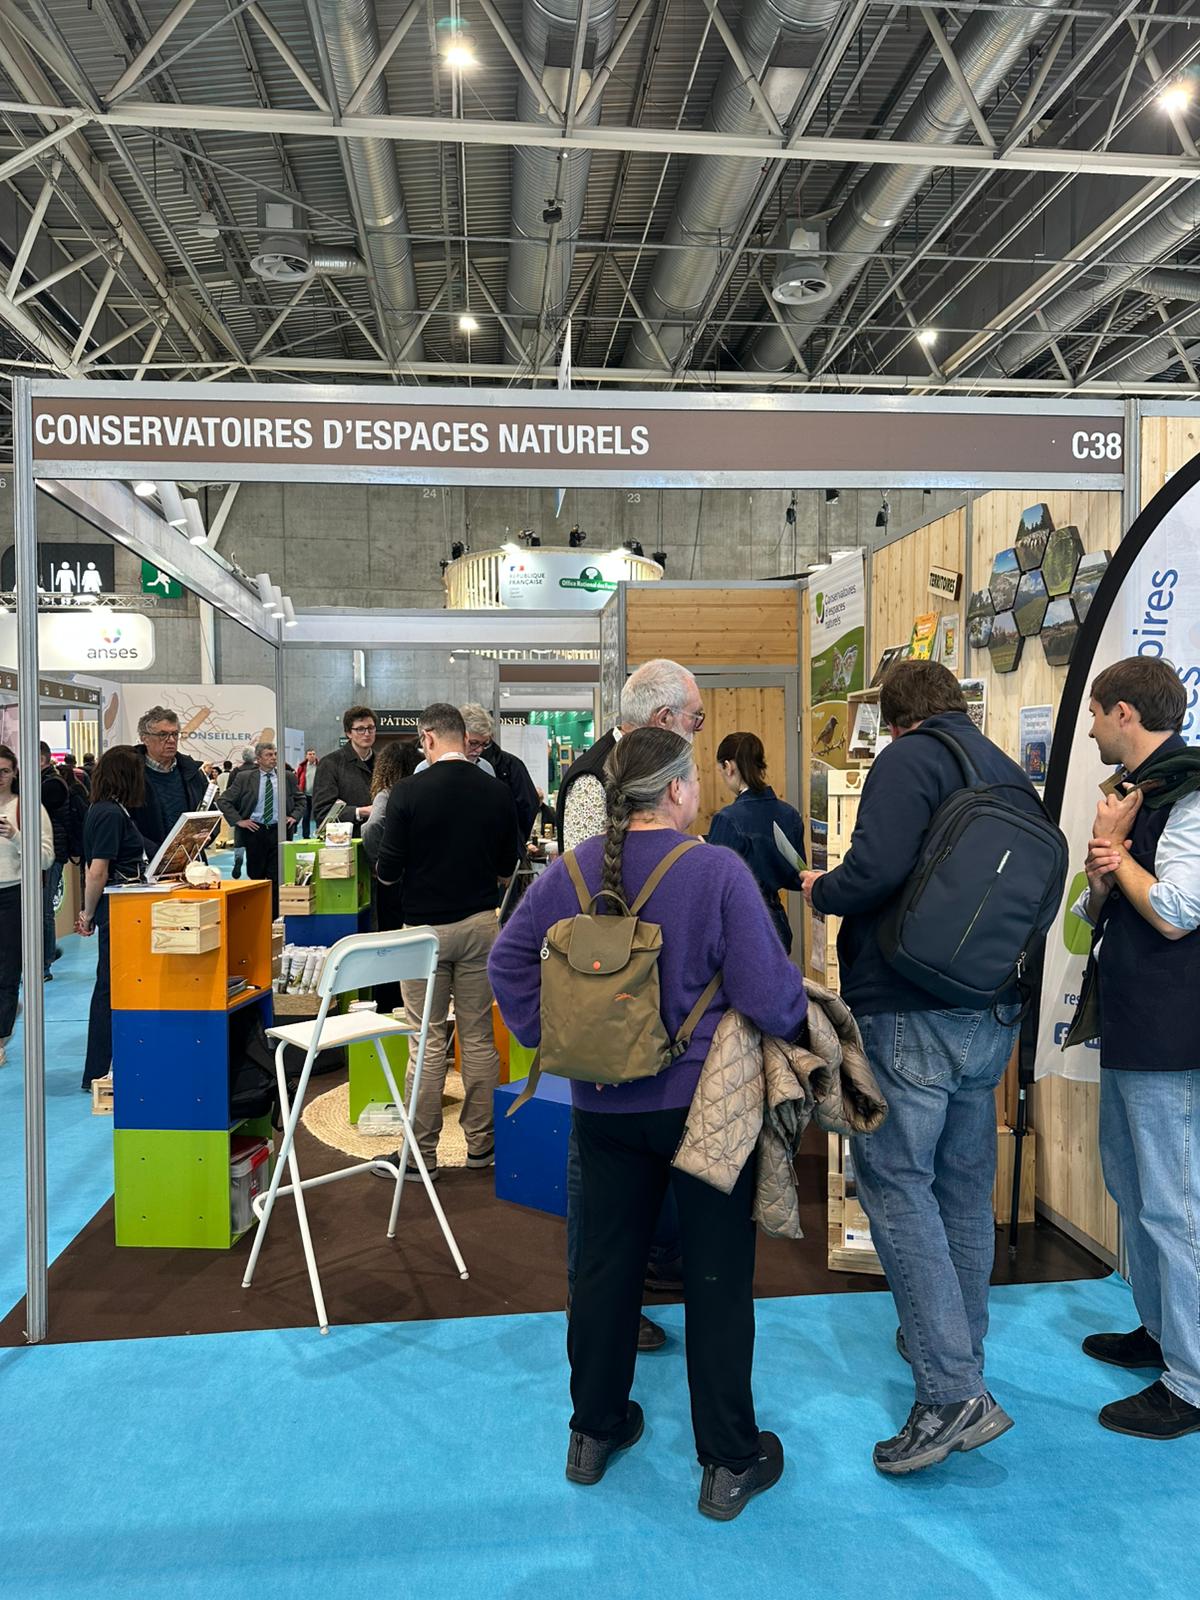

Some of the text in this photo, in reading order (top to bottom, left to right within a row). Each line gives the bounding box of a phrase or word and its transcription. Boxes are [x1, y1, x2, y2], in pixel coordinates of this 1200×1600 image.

[35, 413, 650, 455] CONSERVATOIRES D’ESPACES NATURELS
[1072, 431, 1122, 460] C38
[423, 488, 436, 499] 24
[627, 493, 641, 503] 23
[1132, 569, 1179, 658] oires
[87, 648, 138, 659] anses
[181, 731, 252, 741] CONSEILLER
